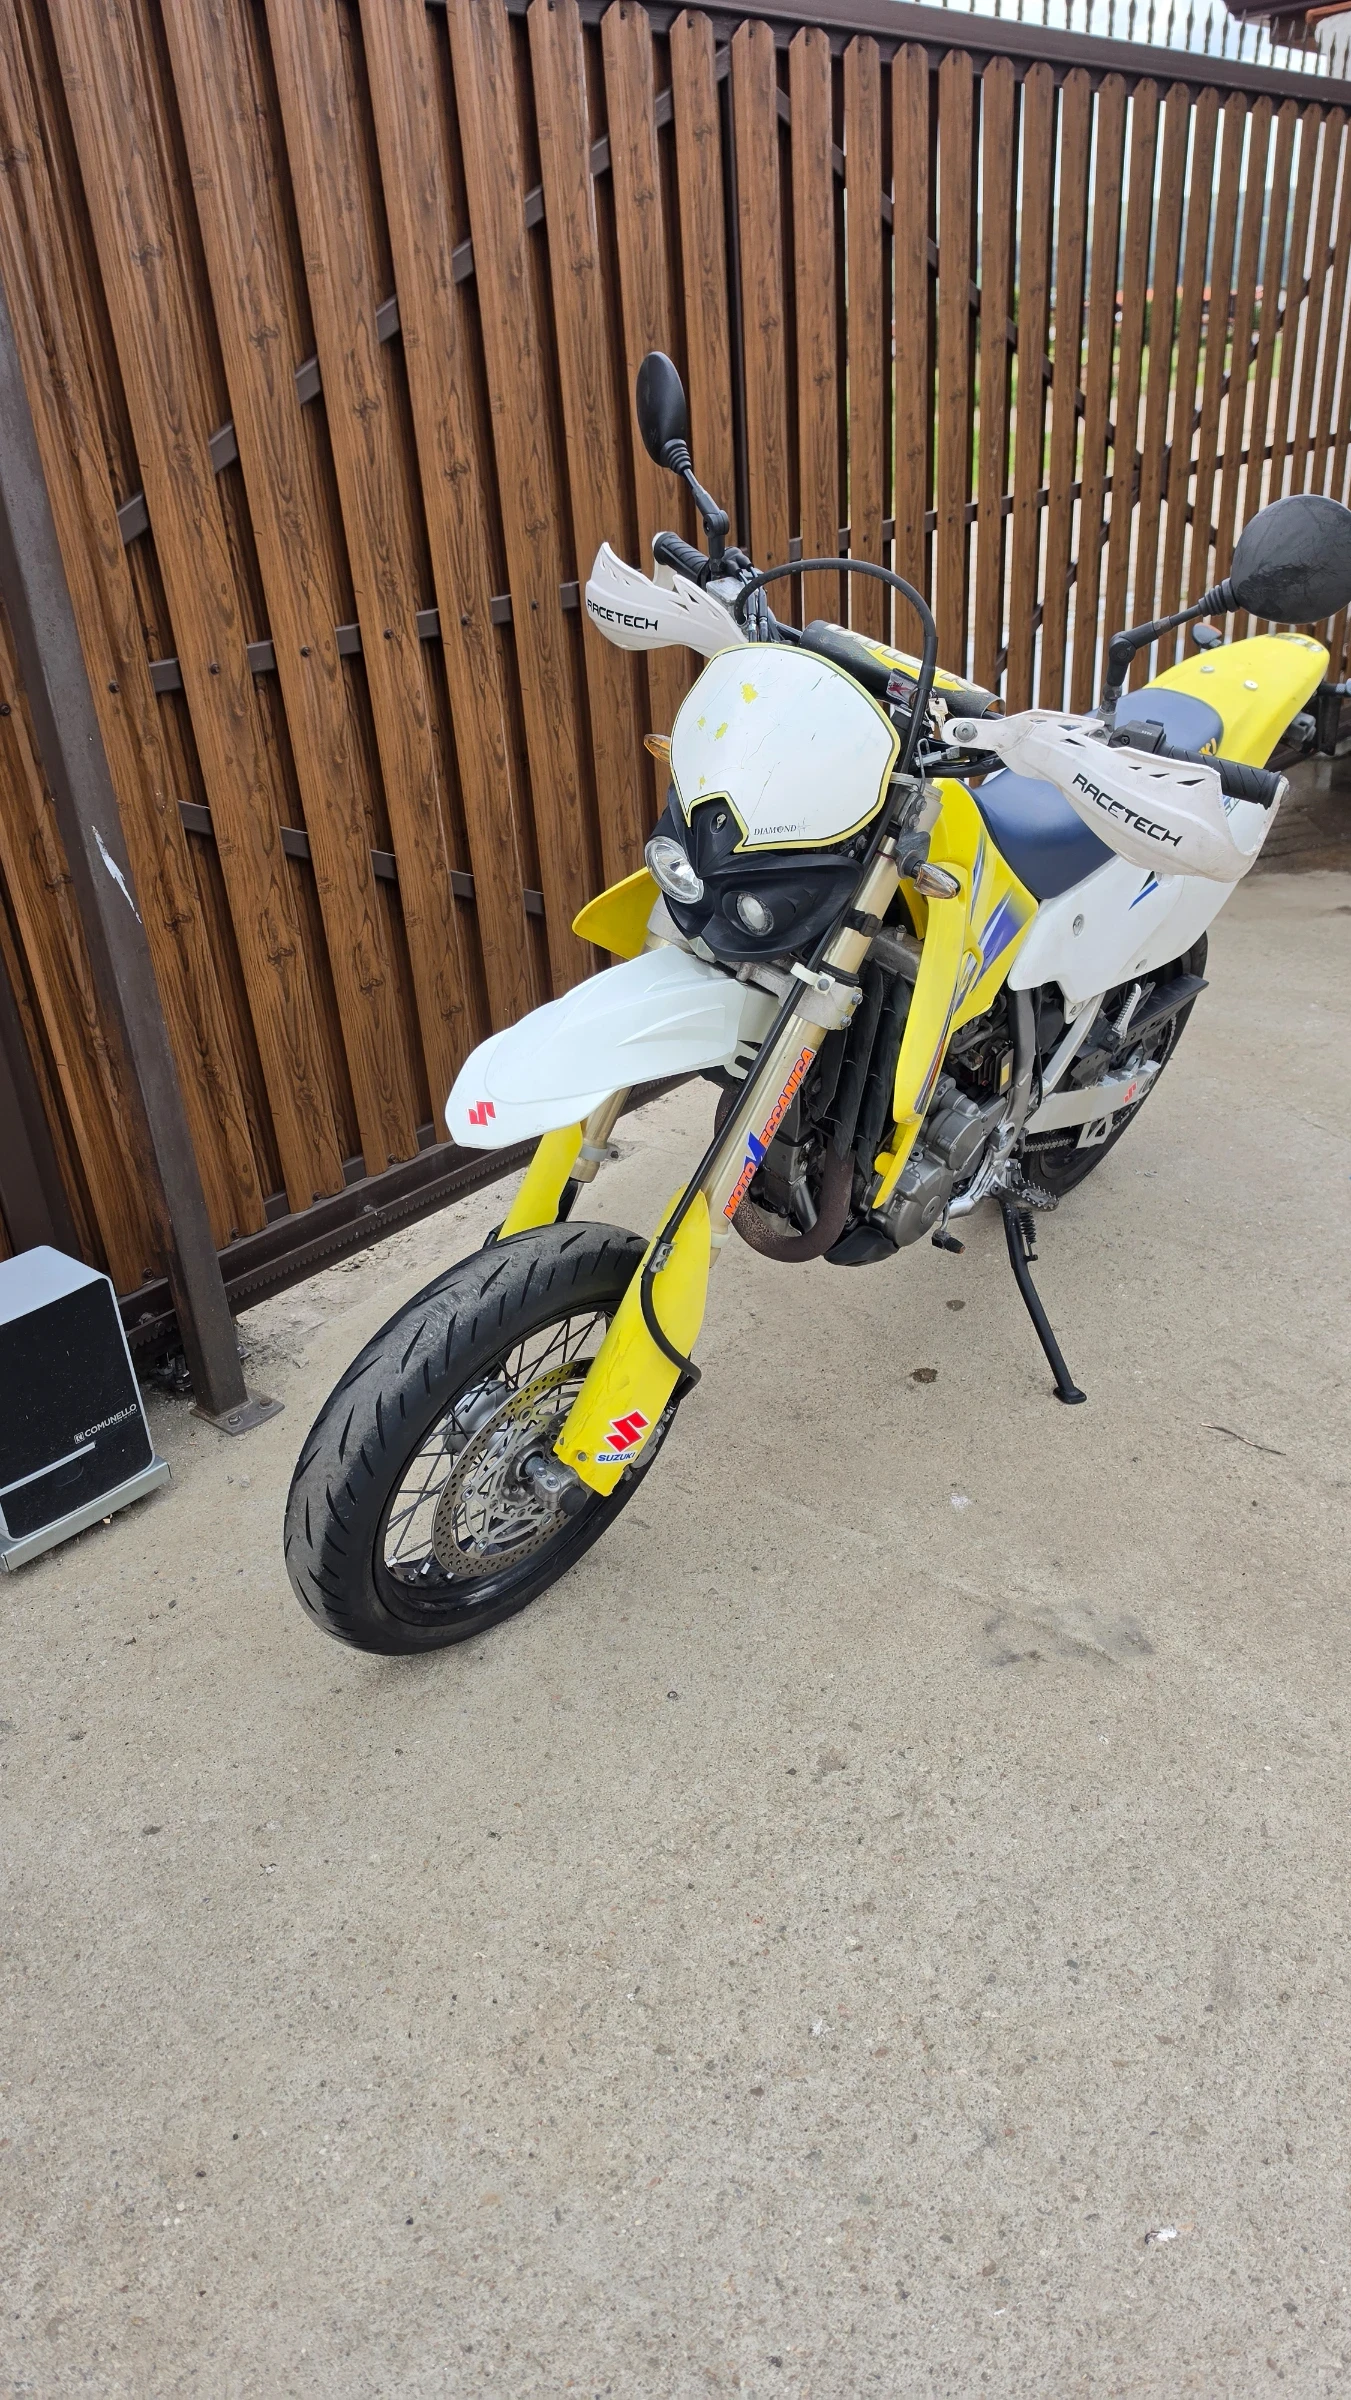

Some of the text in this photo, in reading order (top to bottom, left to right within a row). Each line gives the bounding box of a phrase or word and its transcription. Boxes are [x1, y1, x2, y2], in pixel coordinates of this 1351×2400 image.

[587, 599, 658, 631] RACETECH
[1072, 773, 1183, 847] RACETECH
[754, 825, 797, 835] DIAMOND
[723, 1161, 756, 1221] MOTO
[84, 1403, 137, 1437] COMUNELLO
[597, 1451, 636, 1462] SUZUKI
